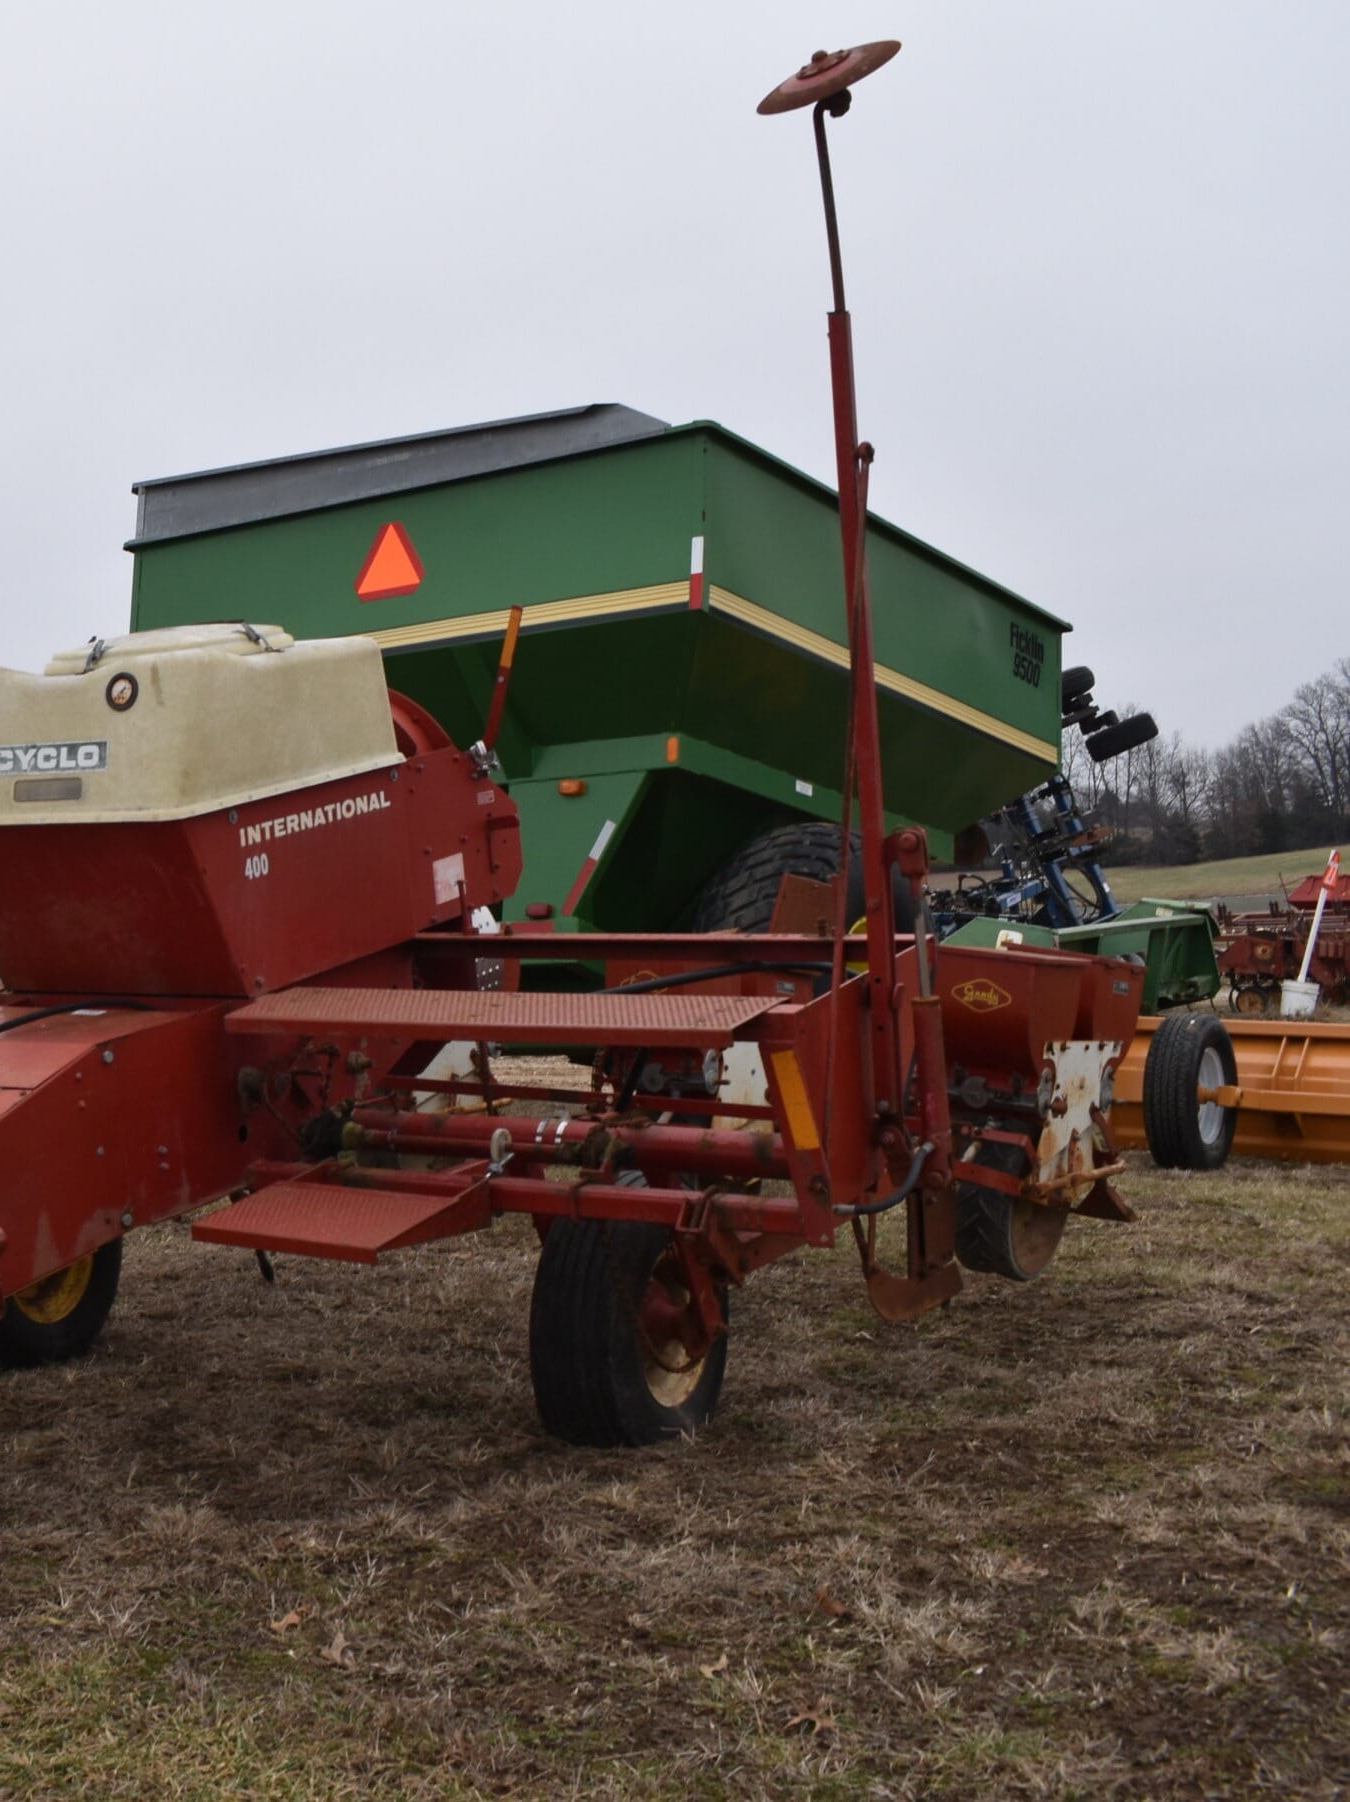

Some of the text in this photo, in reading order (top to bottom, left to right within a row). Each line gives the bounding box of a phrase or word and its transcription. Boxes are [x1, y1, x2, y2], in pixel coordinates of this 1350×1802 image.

[1011, 622, 1044, 664] Ficklin
[1013, 652, 1041, 688] 9500
[239, 791, 391, 847] INTERNATIONAL
[245, 853, 269, 880] 400
